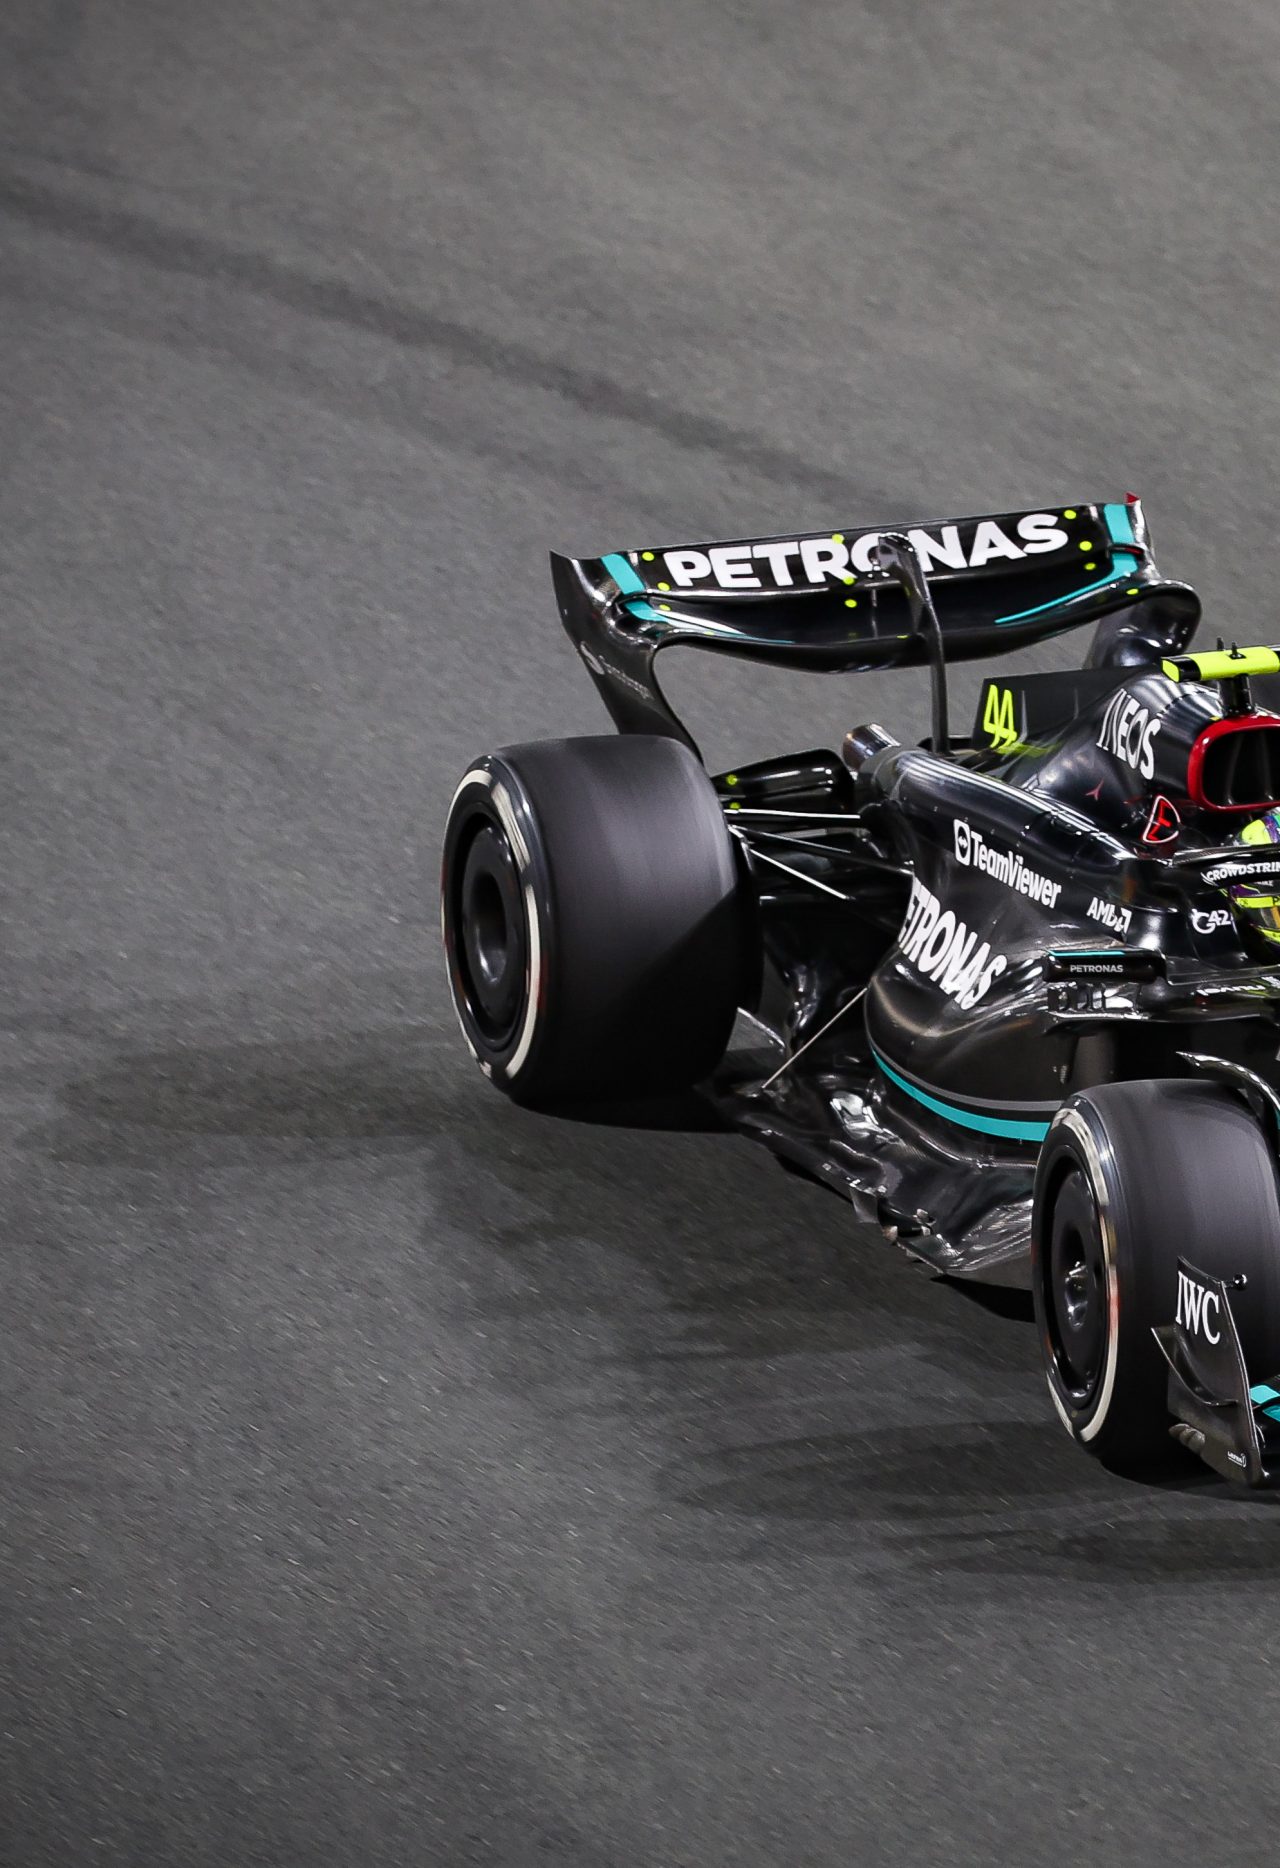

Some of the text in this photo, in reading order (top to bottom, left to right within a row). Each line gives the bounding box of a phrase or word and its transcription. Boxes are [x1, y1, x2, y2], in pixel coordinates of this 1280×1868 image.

[984, 684, 1017, 749] 44
[1096, 688, 1161, 780] INEOS
[970, 831, 1062, 909] TeamViewer
[898, 876, 1008, 1010] ETRONAS
[1070, 964, 1124, 973] PETRONAS
[1175, 1271, 1221, 1345] IWC
